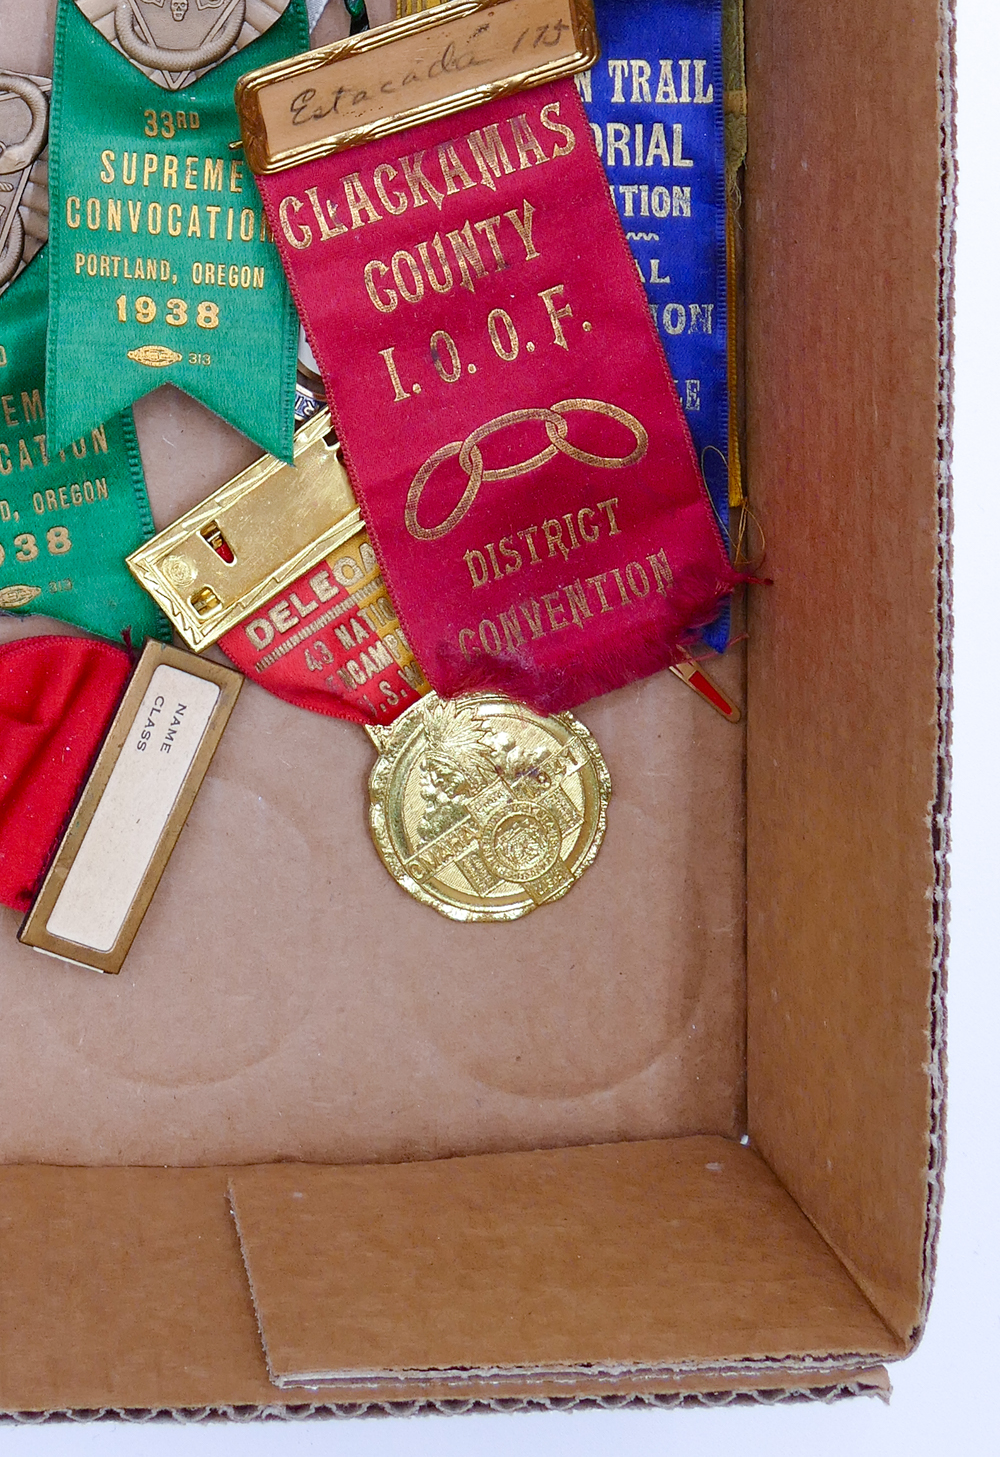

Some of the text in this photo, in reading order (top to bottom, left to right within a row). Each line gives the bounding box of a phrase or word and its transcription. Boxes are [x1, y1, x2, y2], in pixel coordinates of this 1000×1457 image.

[608, 59, 714, 103] TRAIL
[142, 109, 201, 139] 33RD
[100, 149, 243, 194] SUPREME
[276, 100, 578, 251] CLACKAMAS
[75, 251, 265, 289] PORTLAND, OREGON
[363, 198, 540, 315] COUNTY
[115, 294, 220, 329] 1938
[377, 284, 593, 403] I. O. O. F.
[33, 477, 109, 515] OREGON
[463, 497, 621, 589] DISTRICT
[456, 547, 675, 662] CONVENTION
[303, 640, 334, 672] 43
[135, 694, 165, 753] CLASS
[158, 702, 187, 755] NAME
